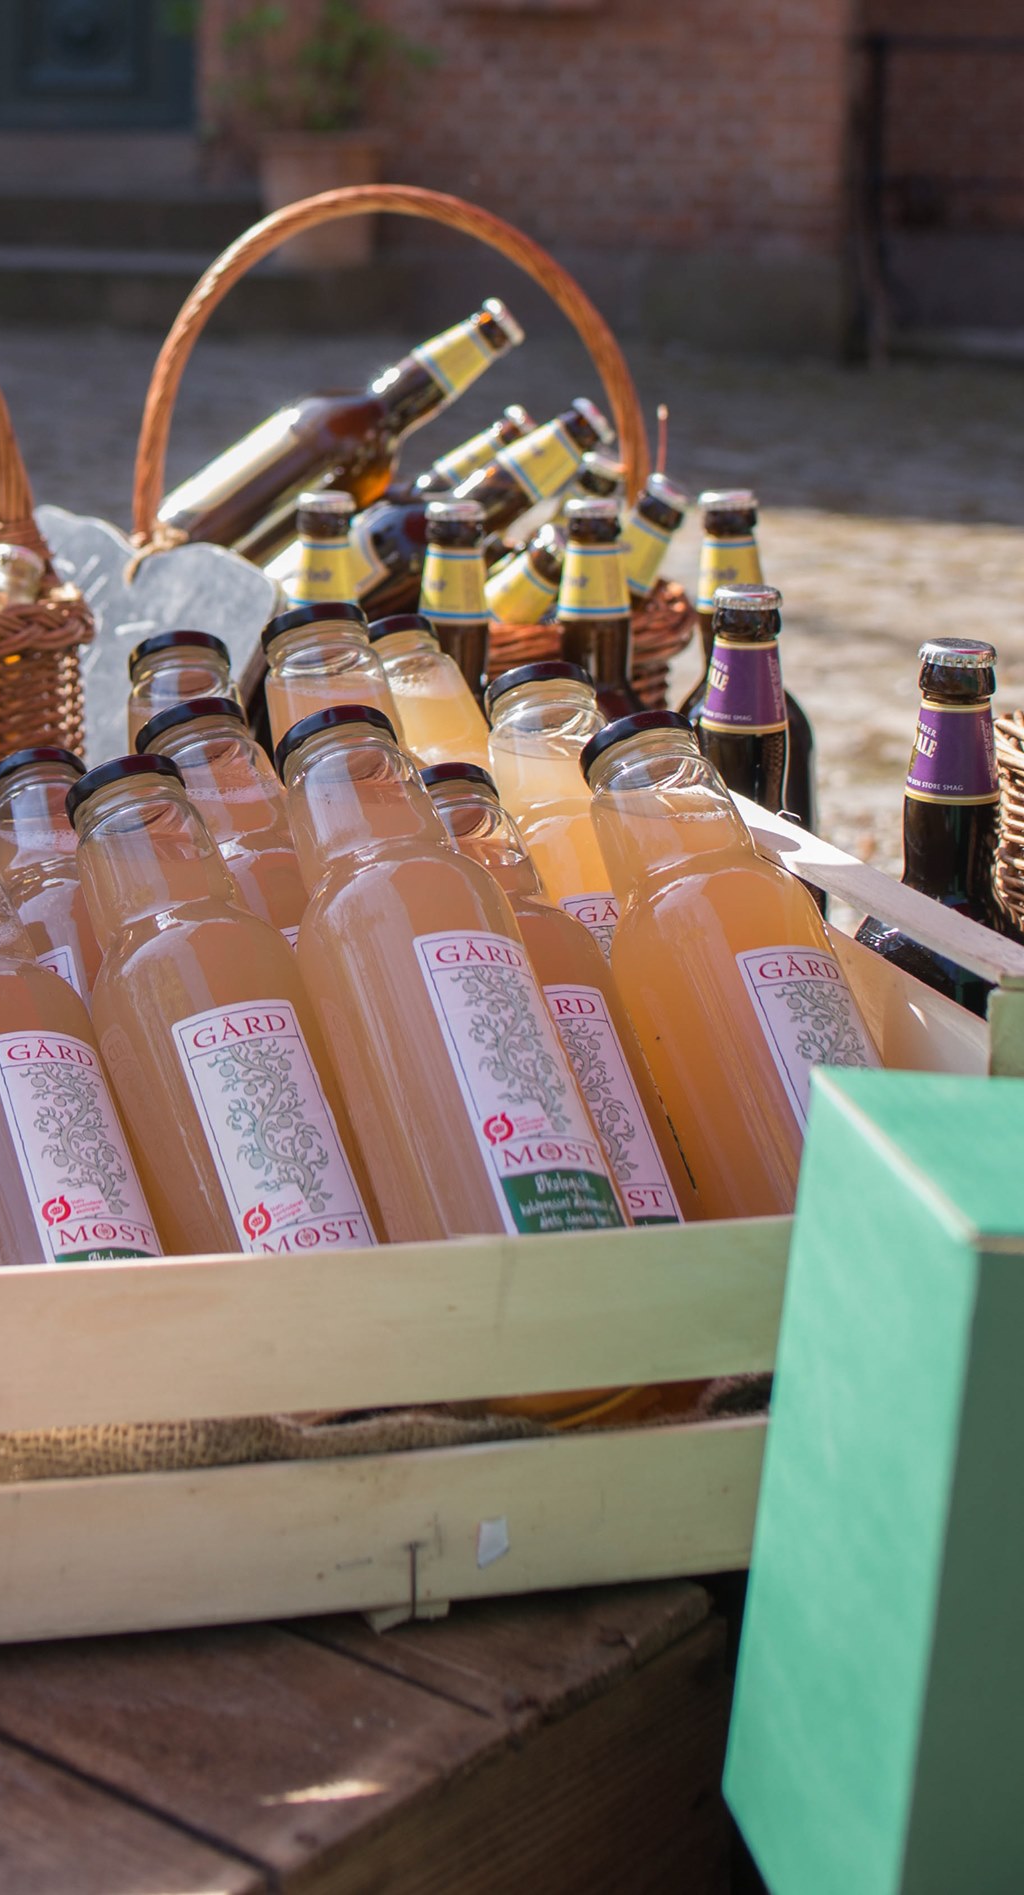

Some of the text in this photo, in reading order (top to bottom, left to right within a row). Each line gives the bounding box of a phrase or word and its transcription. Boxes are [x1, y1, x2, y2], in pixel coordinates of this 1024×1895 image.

[921, 781, 941, 791] STORE
[942, 783, 964, 792] SMAG
[576, 900, 619, 924] GÅ
[435, 940, 522, 968] GÅRD
[758, 954, 840, 981] GÅRD
[553, 998, 596, 1015] RD
[192, 1012, 287, 1049] GÅRD
[7, 1038, 94, 1067] GÅRD
[501, 1141, 597, 1169] MOST
[628, 1189, 664, 1210] ST
[57, 1223, 152, 1247] MOST
[261, 1219, 358, 1255] MOST
